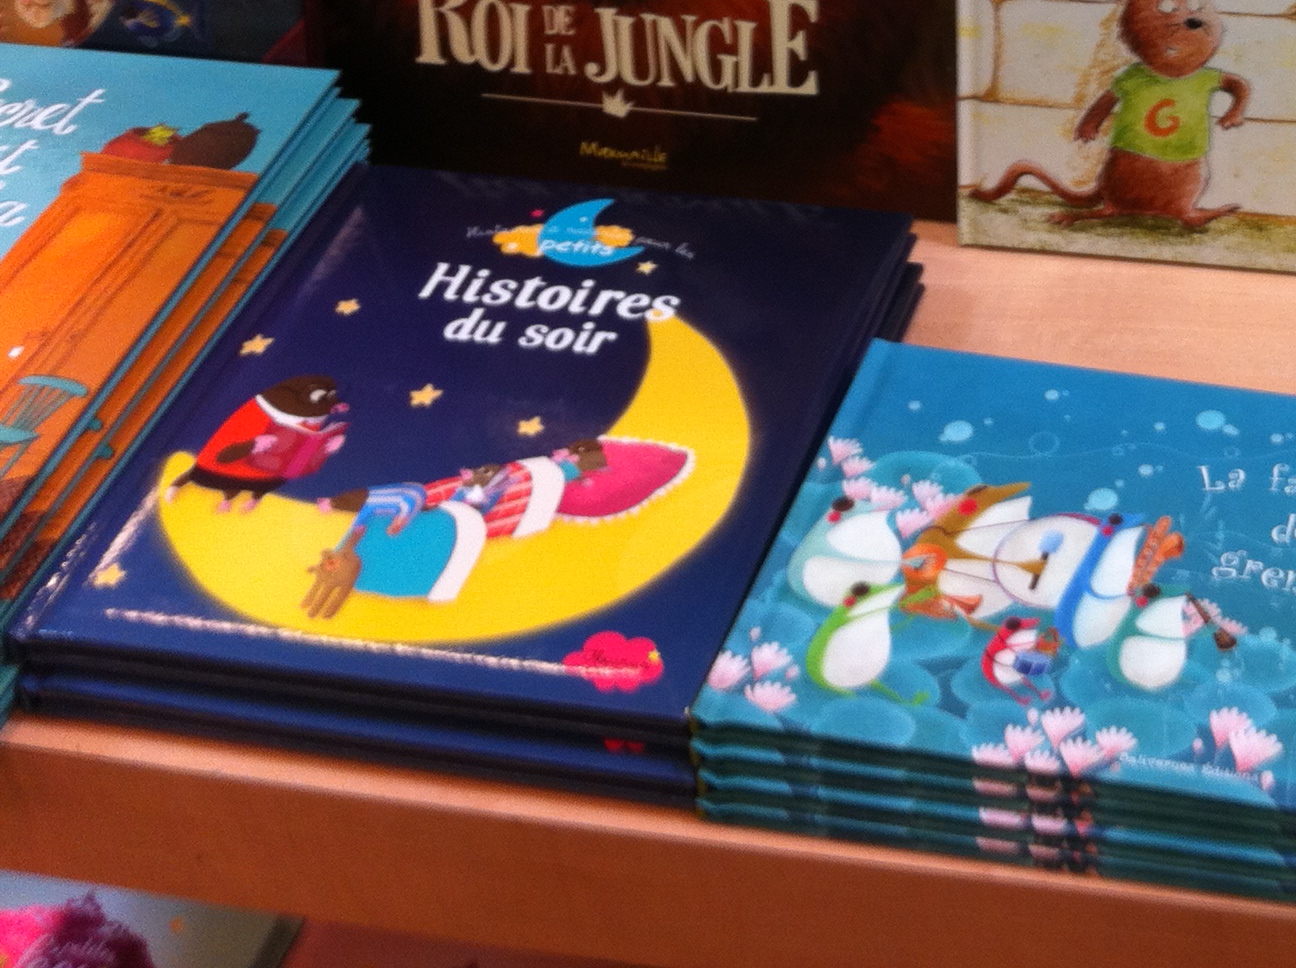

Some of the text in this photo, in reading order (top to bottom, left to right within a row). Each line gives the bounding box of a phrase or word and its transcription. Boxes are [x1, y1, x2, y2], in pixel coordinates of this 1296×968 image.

[543, 3, 576, 36] DE
[544, 43, 577, 76] LA
[1143, 97, 1181, 138] G
[539, 239, 616, 257] petits
[417, 262, 682, 323] Histoires
[442, 307, 619, 355] du soir
[1196, 464, 1247, 492] La
